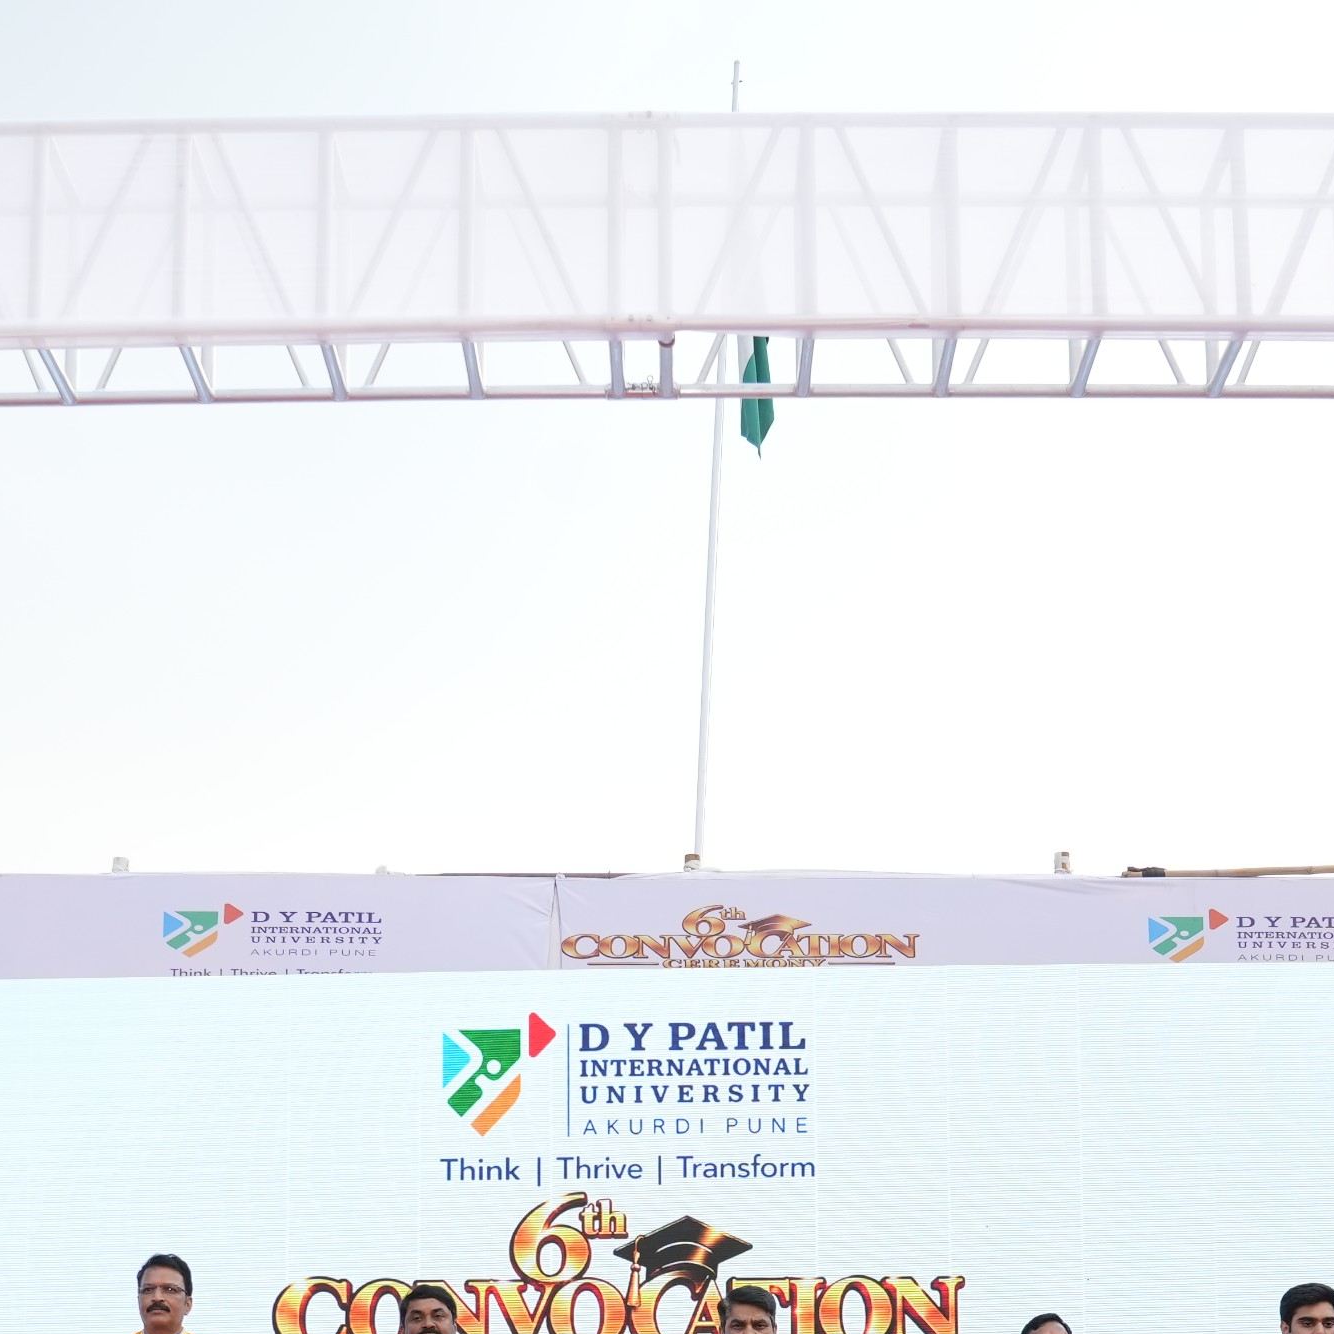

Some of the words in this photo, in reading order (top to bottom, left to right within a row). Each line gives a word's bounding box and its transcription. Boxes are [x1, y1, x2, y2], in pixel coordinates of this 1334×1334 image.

[251, 911, 270, 923] D
[279, 911, 297, 923] Y
[306, 912, 382, 923] PATIL
[682, 904, 746, 936] 6th
[1236, 917, 1255, 928] D
[1265, 917, 1283, 928] Y
[251, 936, 382, 944] UNIVERSITY
[560, 931, 920, 959] CONVOCATION
[329, 949, 377, 957] PUNE
[1238, 954, 1305, 962] AKURDI
[662, 959, 826, 968] CEREMONY
[579, 1024, 610, 1052] D
[623, 1023, 653, 1051] Y
[669, 1022, 806, 1051] PATIL
[580, 1058, 808, 1077] INTERNATIONAL
[580, 1084, 810, 1104] UNIVERSITY
[583, 1118, 704, 1135] AKURDI
[727, 1117, 808, 1134] PUNE
[440, 1158, 521, 1181] Think
[556, 1156, 643, 1180] Thrive
[676, 1154, 815, 1179] Transform
[509, 1191, 629, 1286] 6th
